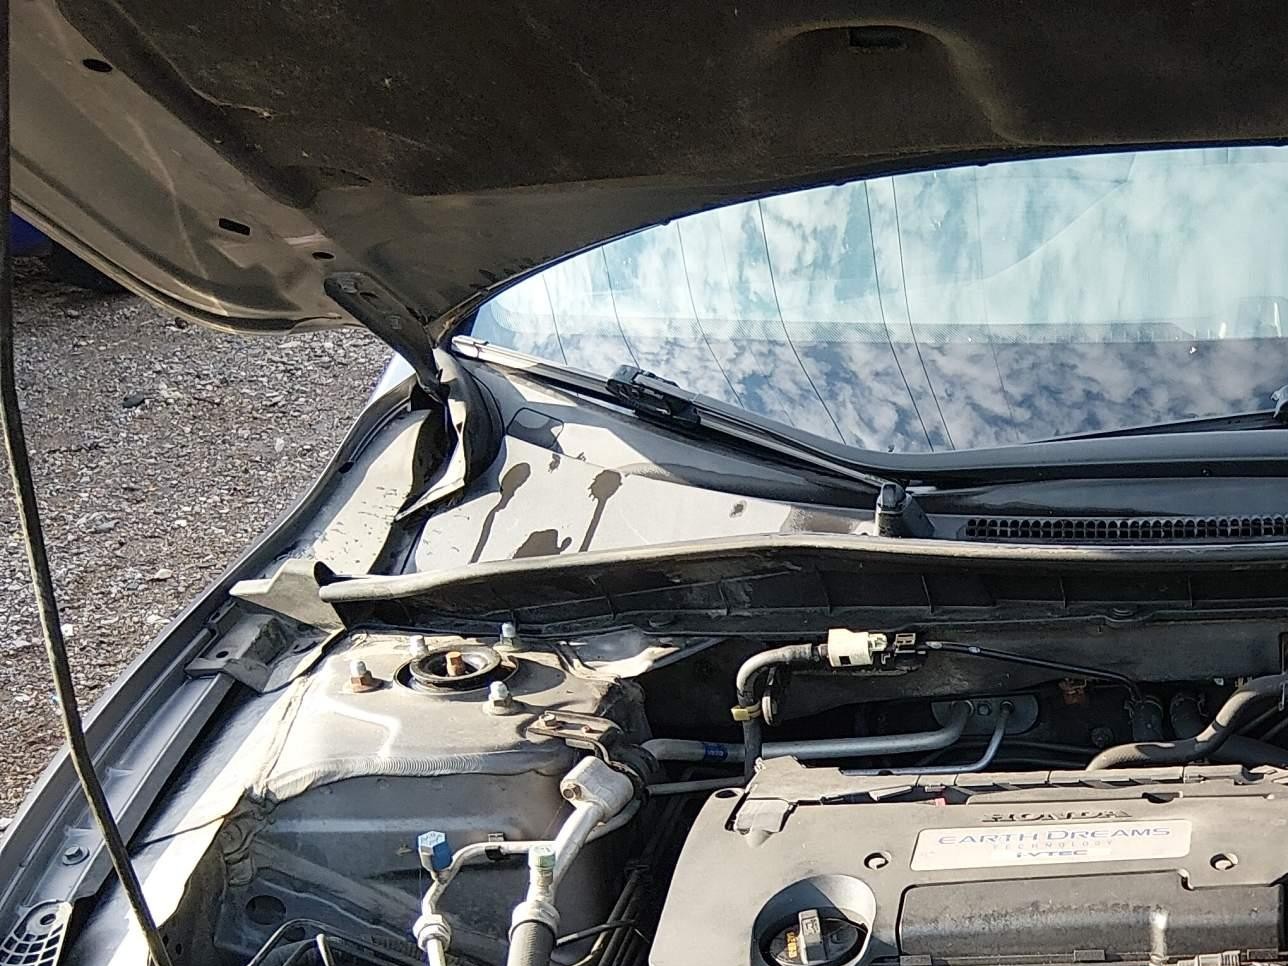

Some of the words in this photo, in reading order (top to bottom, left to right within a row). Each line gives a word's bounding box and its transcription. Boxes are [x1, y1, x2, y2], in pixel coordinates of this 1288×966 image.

[982, 810, 1133, 823] HONDA
[938, 829, 1039, 846] EARTH
[1048, 827, 1171, 841] DREAMS
